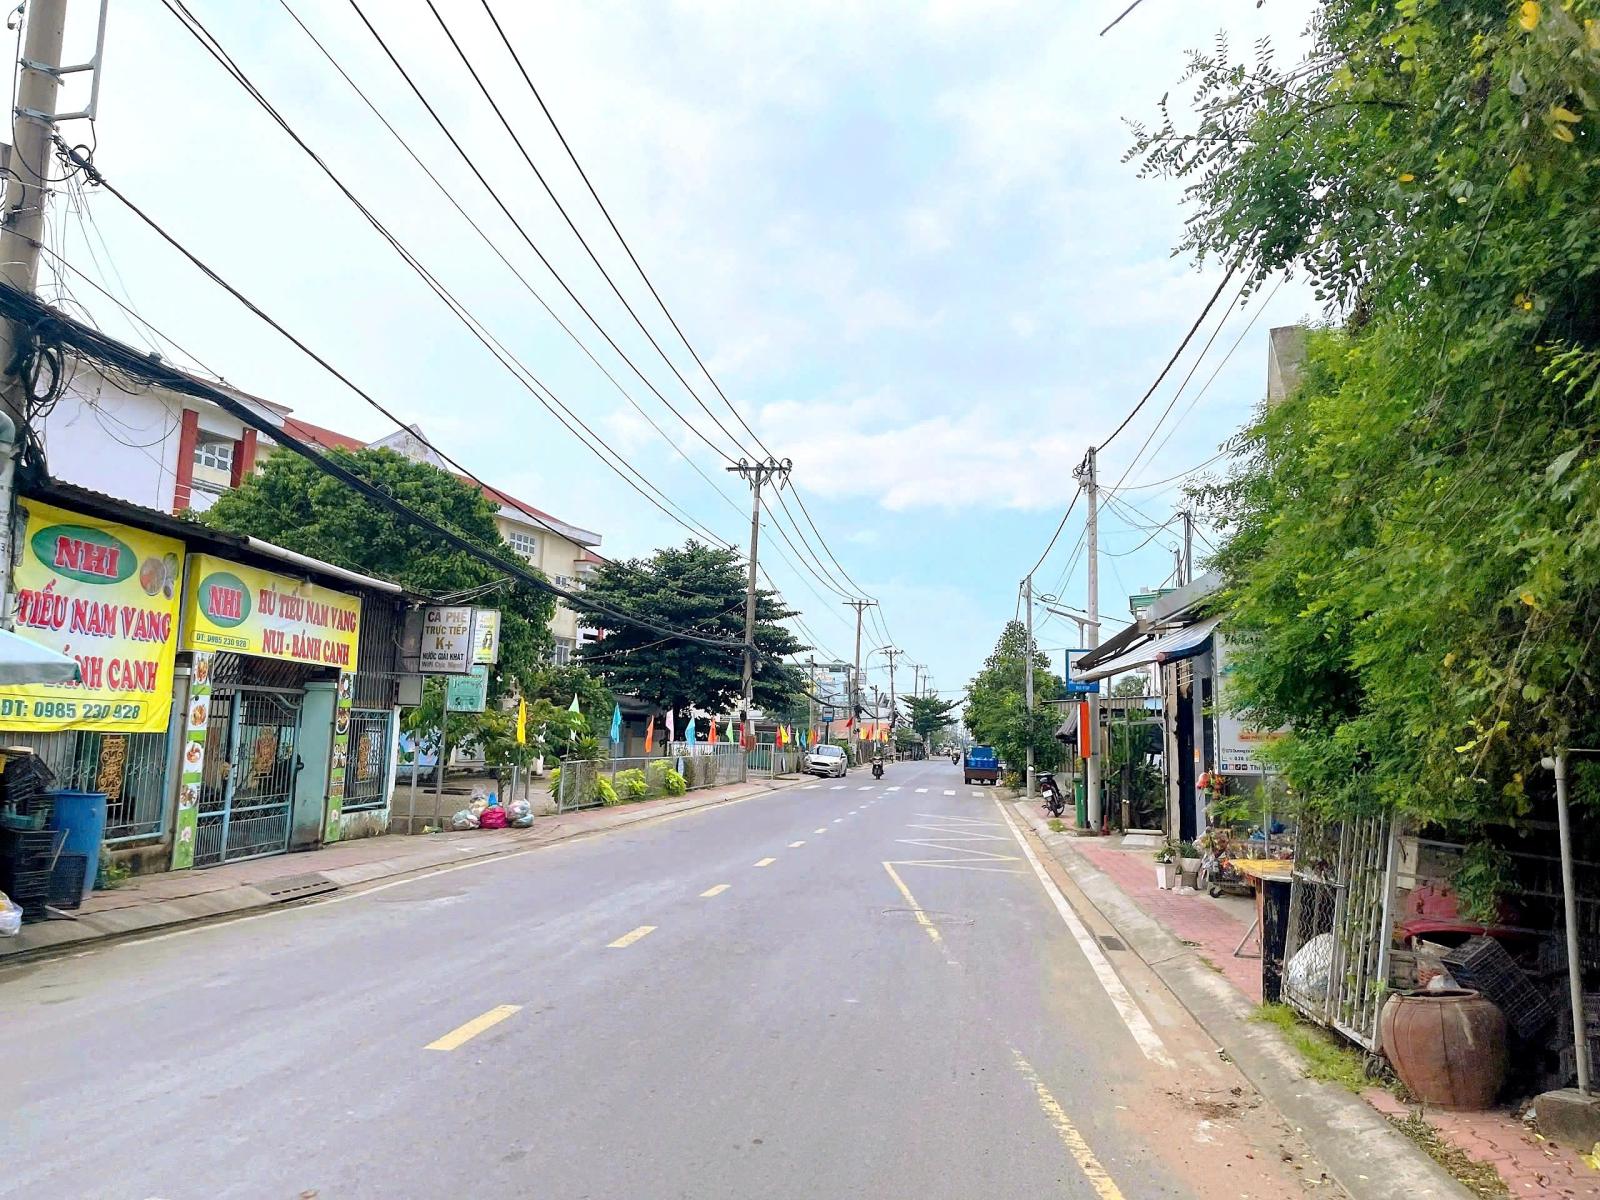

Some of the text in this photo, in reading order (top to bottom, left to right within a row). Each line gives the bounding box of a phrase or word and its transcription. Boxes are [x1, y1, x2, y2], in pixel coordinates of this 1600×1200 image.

[16, 578, 172, 644] TIẾU NAM VANG
[305, 600, 329, 628] NAM
[331, 604, 357, 633] VANG
[207, 634, 222, 644] 0985
[223, 637, 235, 646] 230
[236, 639, 247, 648] 928
[262, 628, 285, 655] NUI
[291, 629, 321, 661] BÁNH
[323, 643, 350, 666] CANH
[436, 637, 454, 650] K+
[107, 658, 159, 693] CANH
[34, 701, 76, 719] 0985
[83, 704, 110, 719] 230
[113, 704, 141, 719] 928
